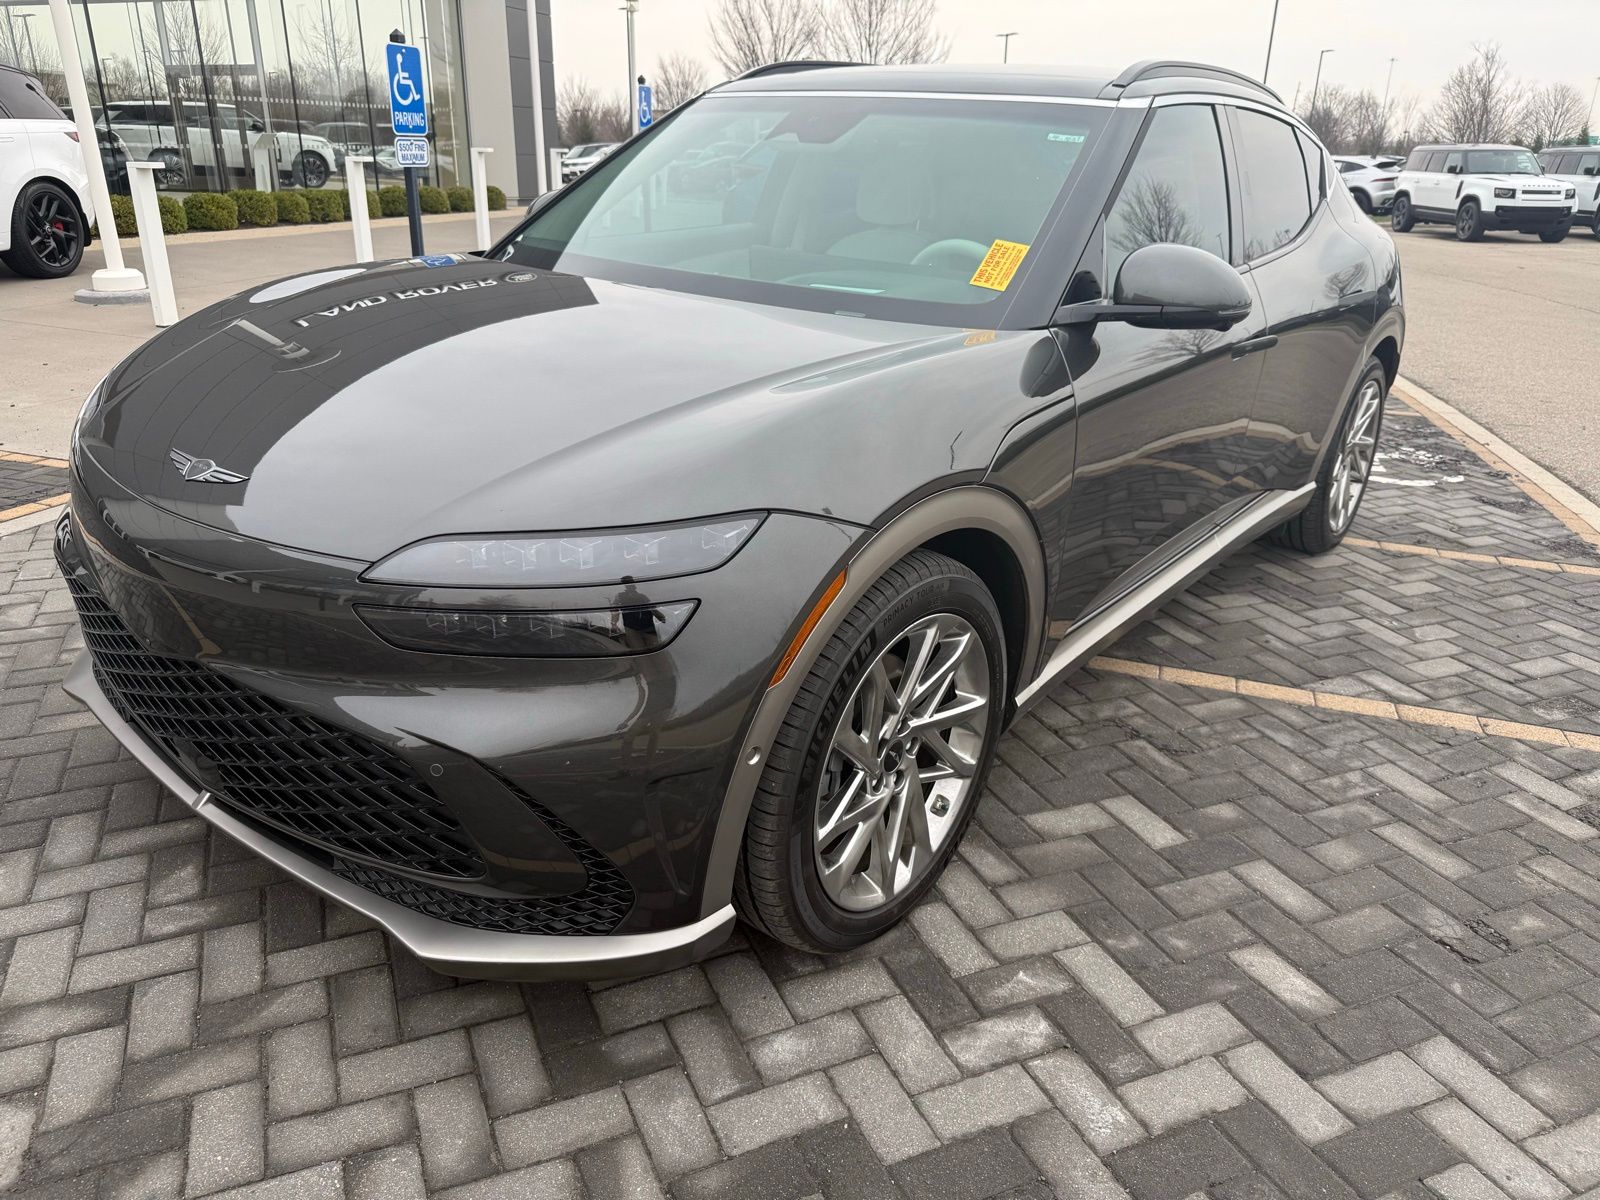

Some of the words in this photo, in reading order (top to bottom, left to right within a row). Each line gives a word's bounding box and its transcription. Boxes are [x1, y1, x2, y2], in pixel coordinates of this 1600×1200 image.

[394, 111, 425, 126] PARKING
[415, 143, 426, 152] FINE
[973, 267, 988, 283] THIS
[982, 242, 1004, 268] VEHICLE
[983, 271, 995, 283] NOT
[991, 259, 1002, 271] FOR
[997, 245, 1010, 260] SALE
[883, 597, 914, 626] PRIMACY
[803, 635, 873, 781] MICHELIN
